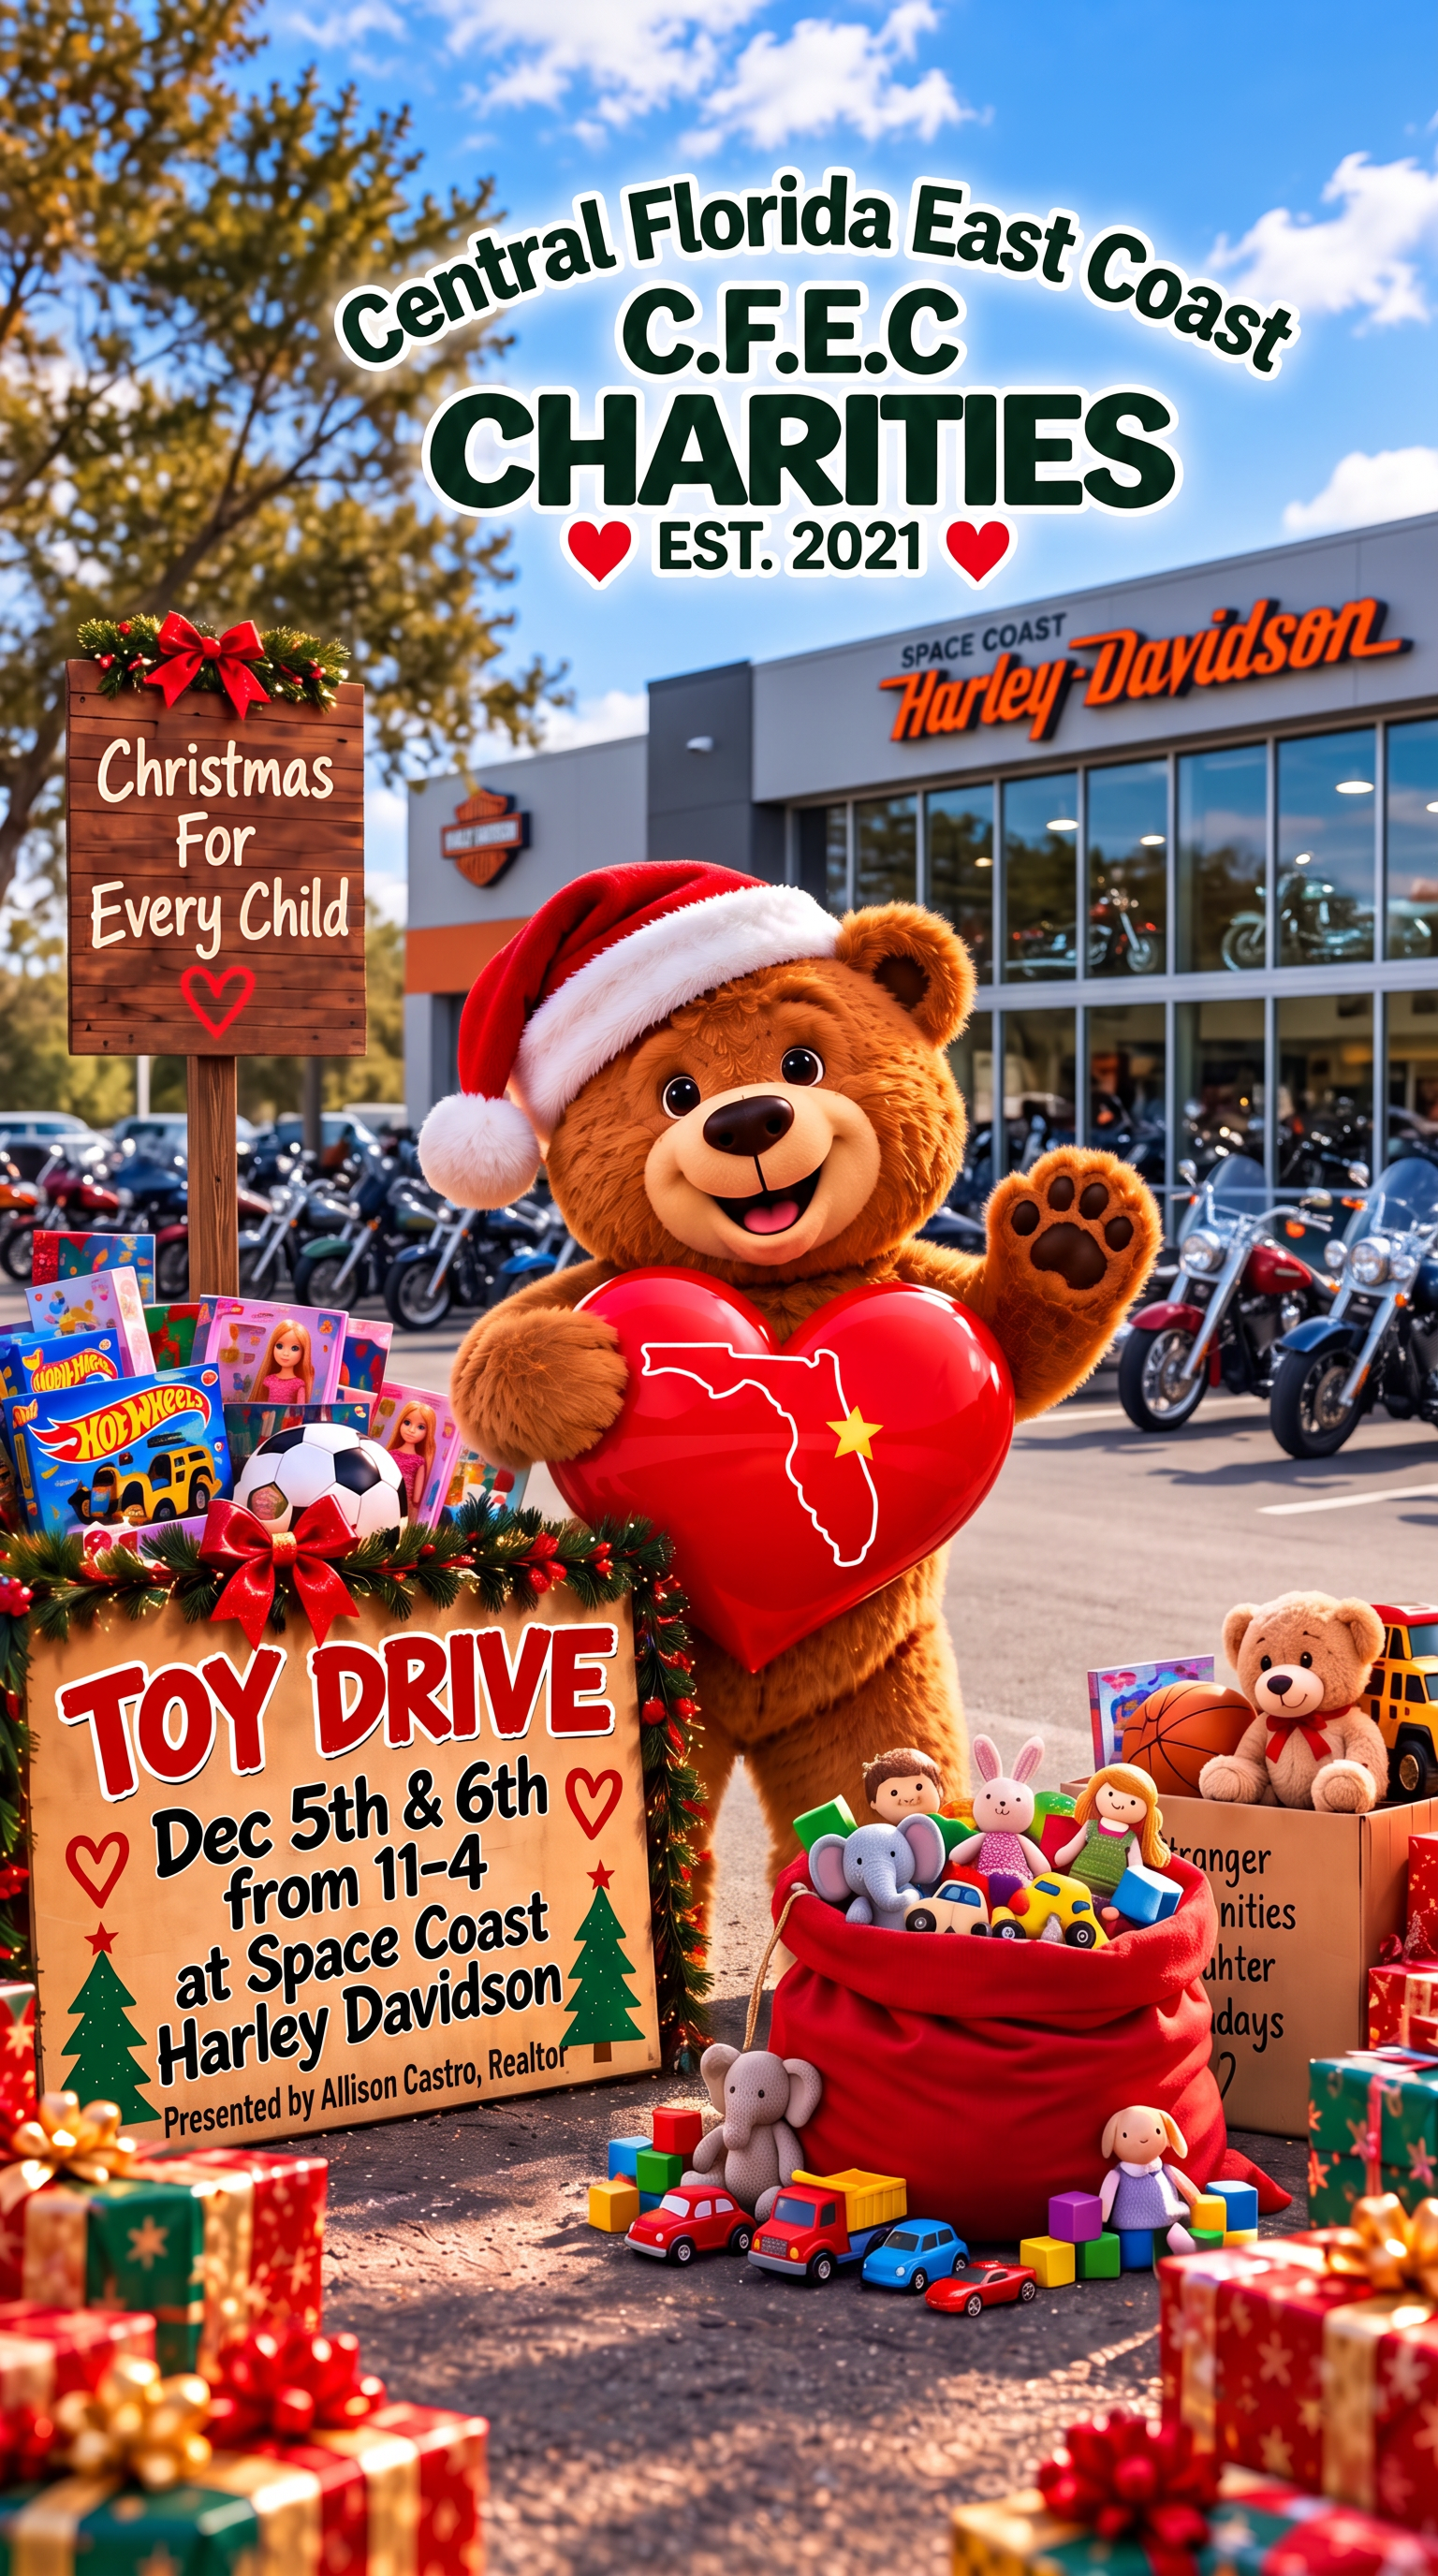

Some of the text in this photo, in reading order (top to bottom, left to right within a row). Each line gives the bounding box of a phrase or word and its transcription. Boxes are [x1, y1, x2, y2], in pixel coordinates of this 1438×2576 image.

[879, 598, 1405, 742] Harley-Davidson
[902, 613, 1067, 668] SPACE COAST
[97, 737, 334, 803] Christmas
[176, 812, 257, 869] For
[91, 876, 349, 960] Every Child
[68, 1411, 129, 1459] HOT
[60, 1627, 615, 1796] TOY DRIVE
[152, 1754, 548, 1879] Dec 5th & 6th
[1159, 1832, 1272, 1888] tranger
[223, 1866, 359, 1931] from
[176, 1892, 549, 2010] at Space Coast
[157, 1963, 562, 2086] Harley Davidson
[1211, 1997, 1284, 2054] days
[164, 2042, 569, 2139] Presented by Allison Castro, Realtor
